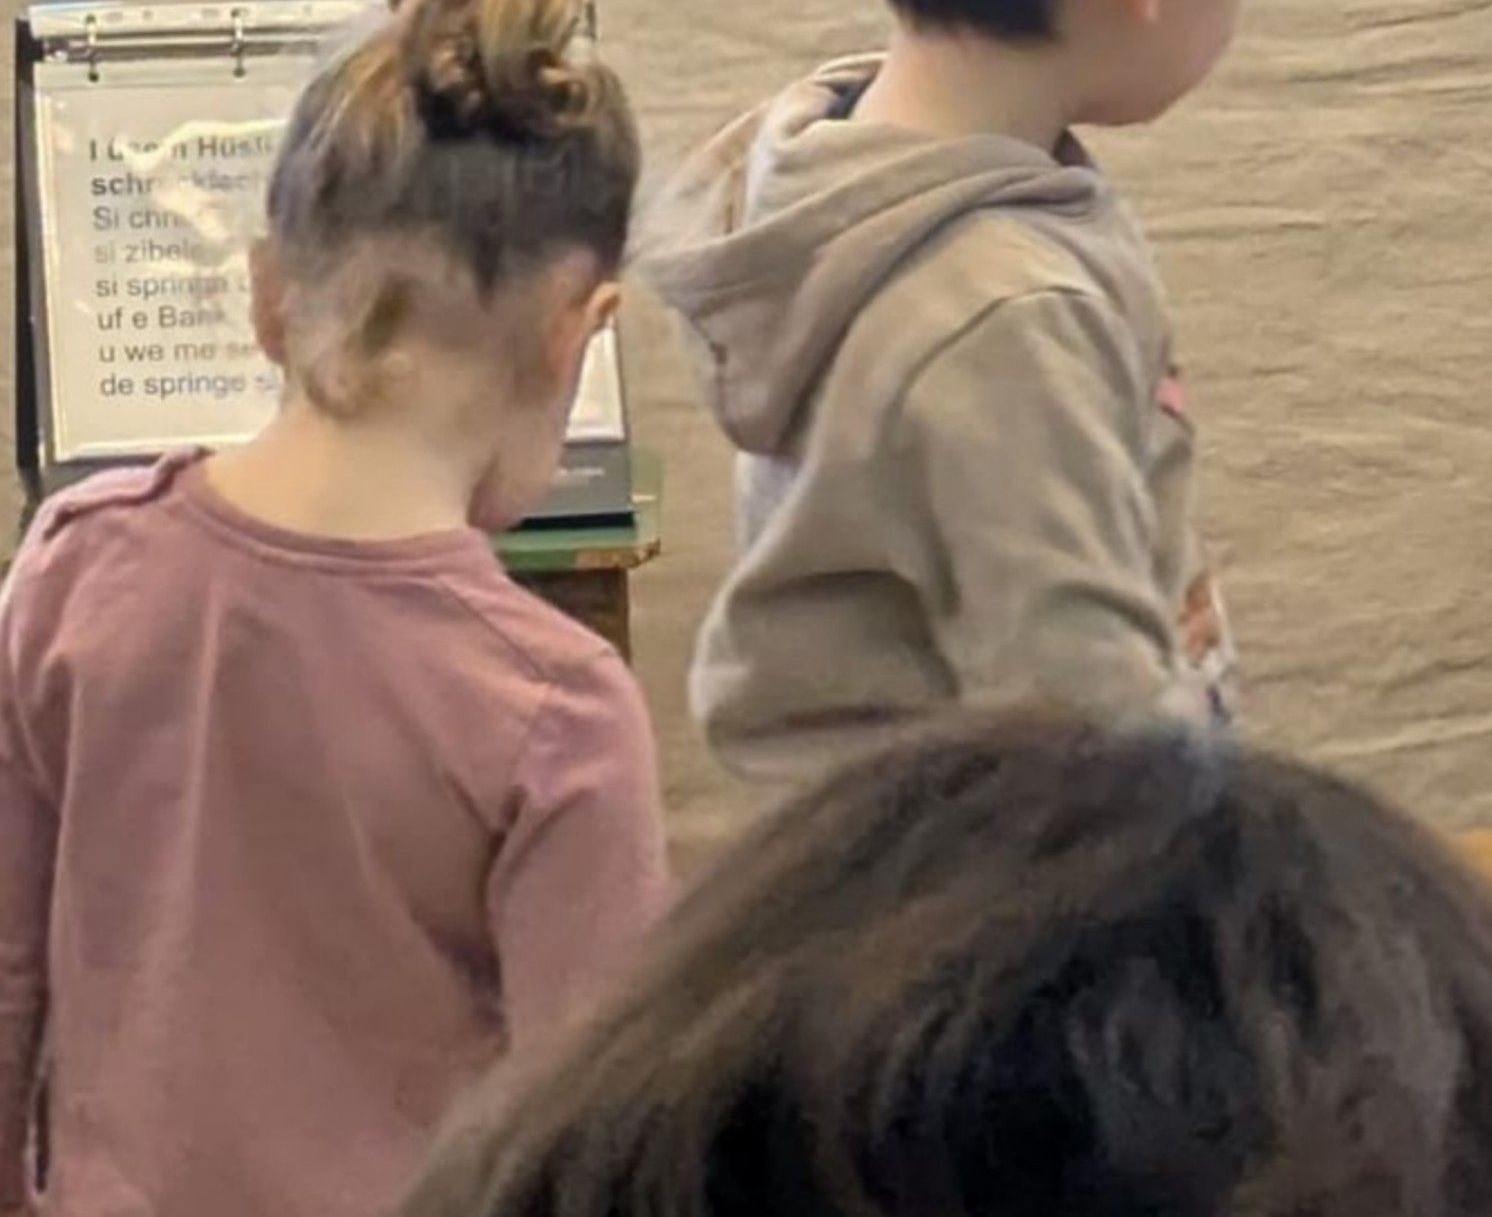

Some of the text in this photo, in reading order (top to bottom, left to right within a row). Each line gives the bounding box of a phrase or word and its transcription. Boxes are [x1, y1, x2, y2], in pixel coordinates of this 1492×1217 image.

[93, 206, 119, 230] Si
[96, 274, 118, 297] si
[97, 307, 122, 330] uf
[132, 311, 148, 329] e
[98, 345, 115, 363] u
[125, 344, 164, 362] we
[174, 342, 216, 361] me
[100, 372, 134, 396] de
[144, 371, 247, 400] springe
